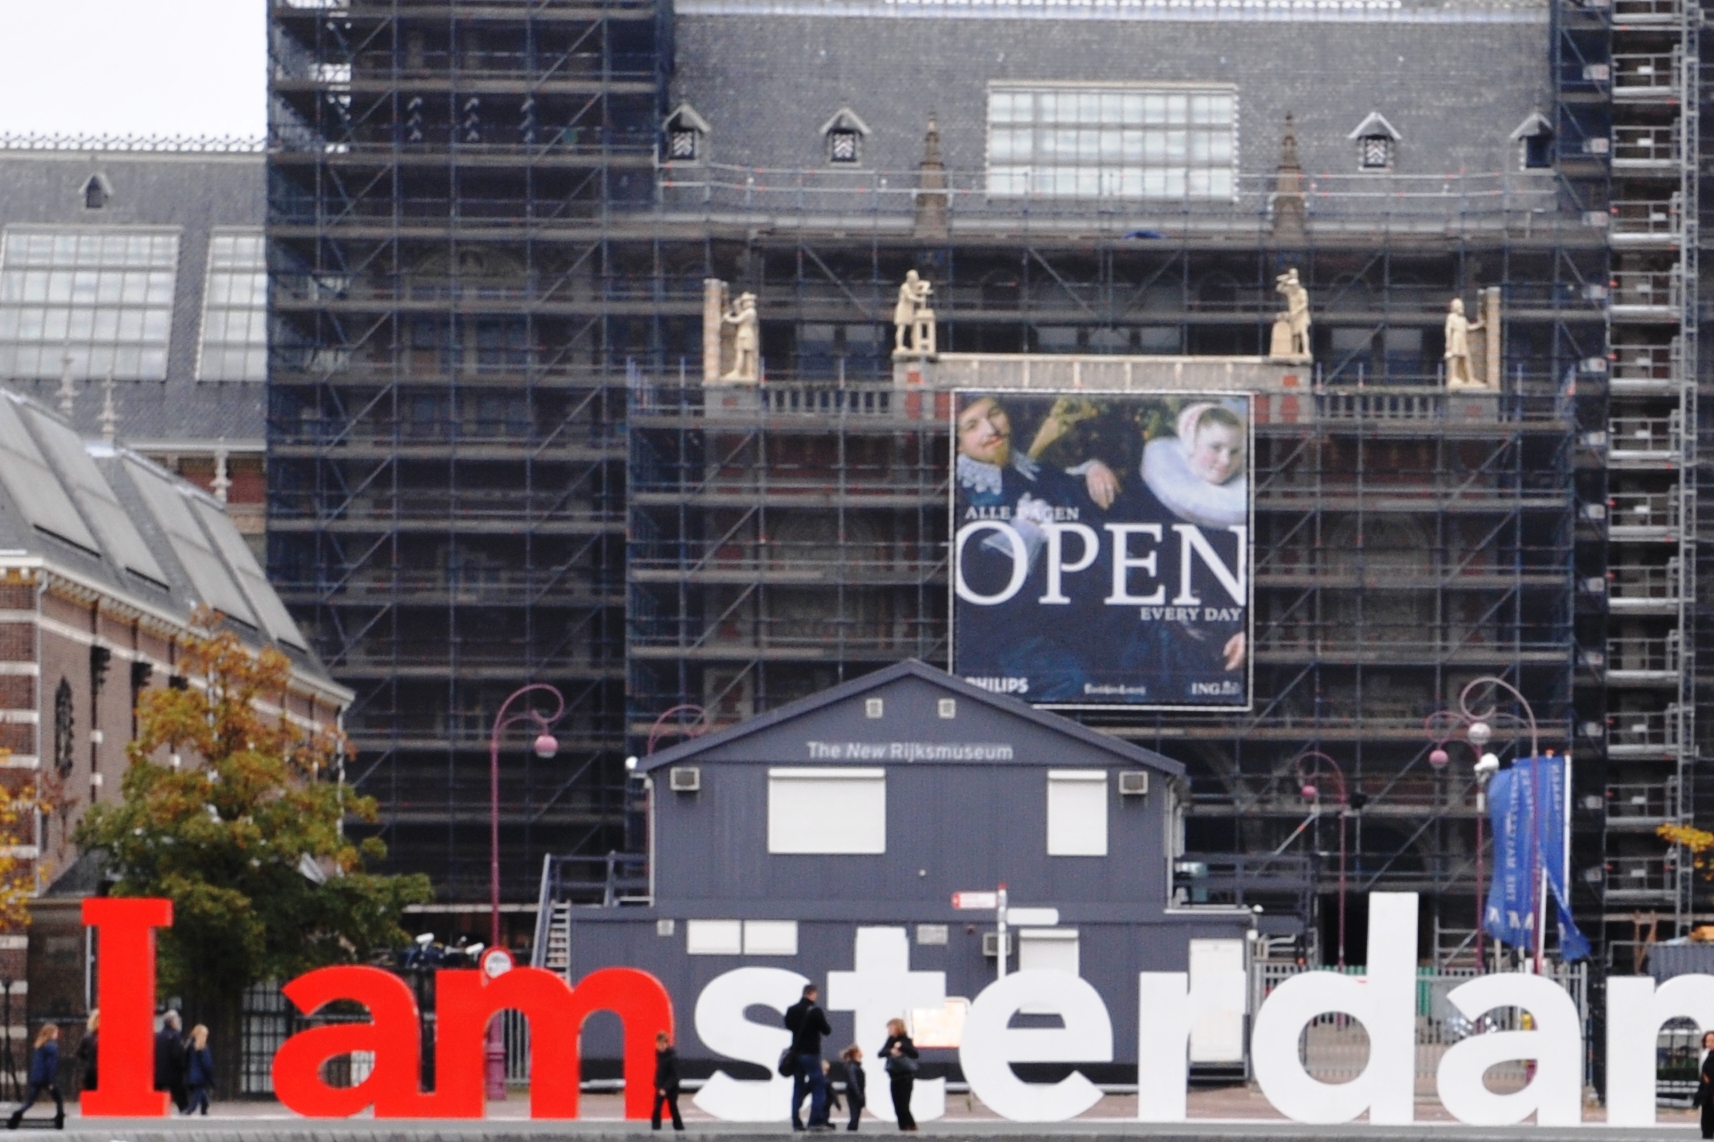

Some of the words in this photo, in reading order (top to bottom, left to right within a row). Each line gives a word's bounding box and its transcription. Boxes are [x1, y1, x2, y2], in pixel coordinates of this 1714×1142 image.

[965, 506, 1010, 520] ALLE
[1017, 506, 1079, 520] GEN
[956, 520, 1247, 606] OPEN
[1140, 607, 1200, 621] EVERY
[1204, 607, 1242, 621] DAY
[1191, 682, 1220, 695] ING
[807, 742, 840, 758] The
[846, 743, 884, 759] New
[890, 743, 1013, 763] Rijksmuseum
[81, 897, 173, 1117] I
